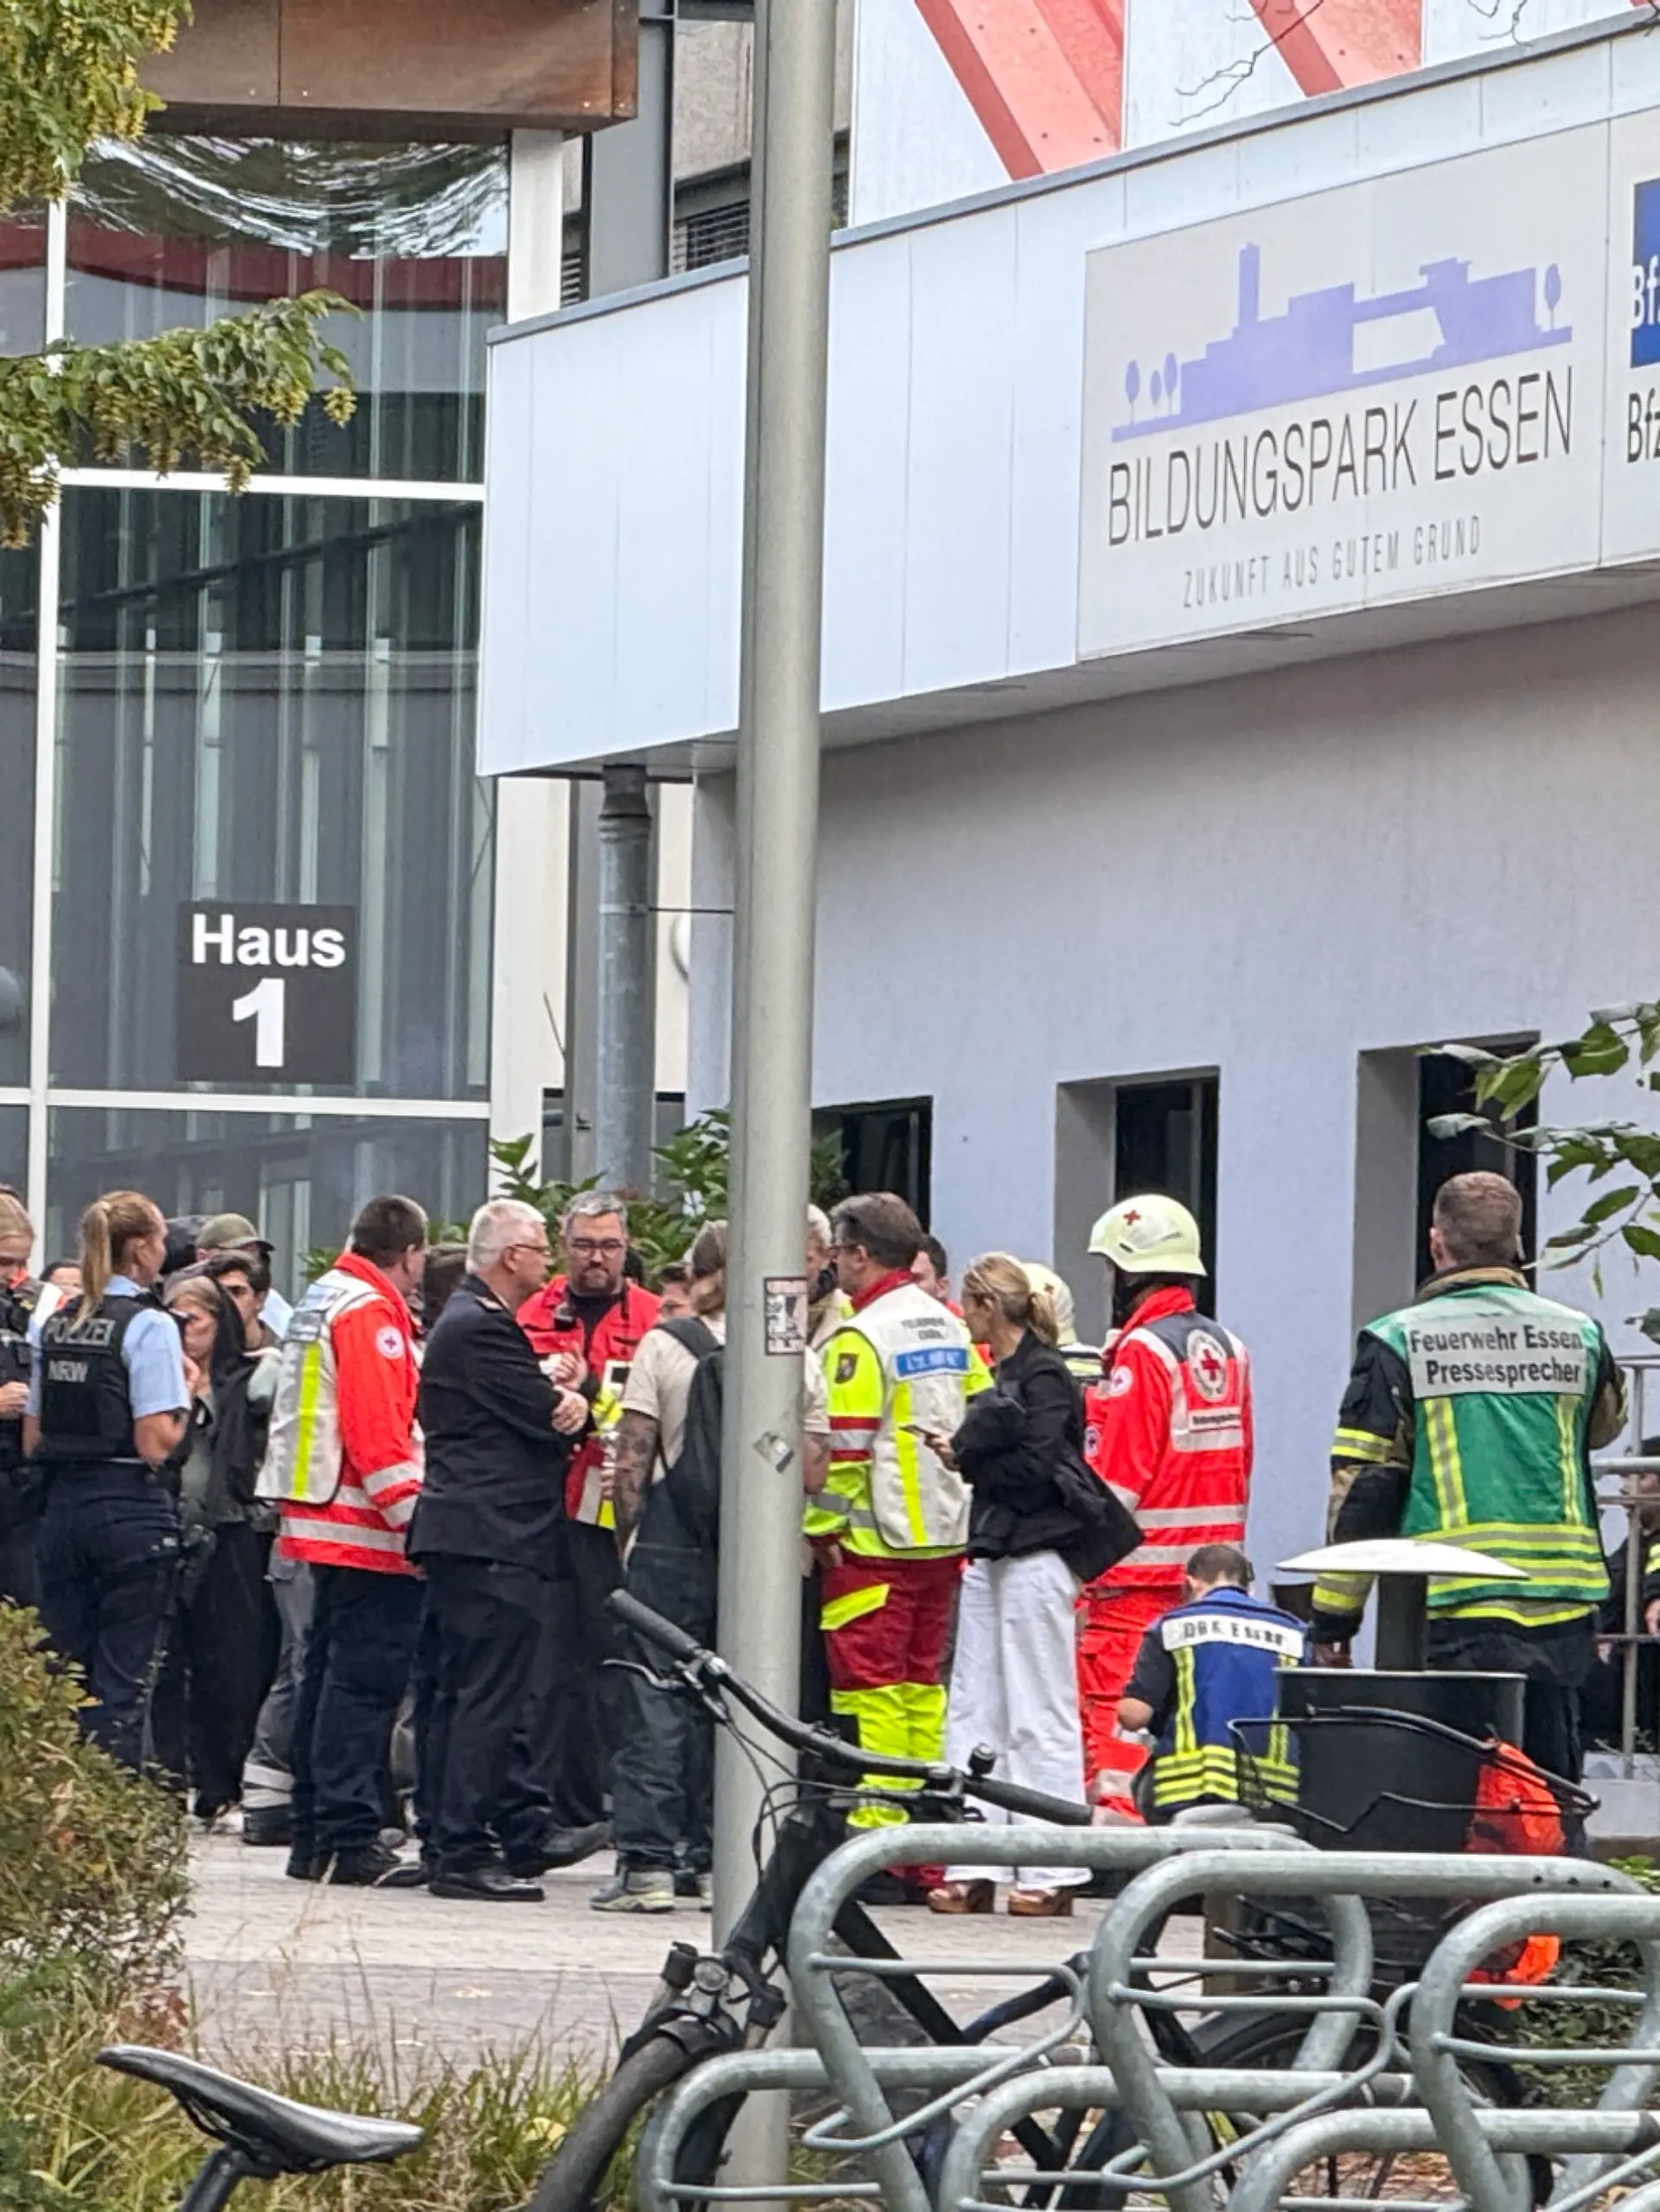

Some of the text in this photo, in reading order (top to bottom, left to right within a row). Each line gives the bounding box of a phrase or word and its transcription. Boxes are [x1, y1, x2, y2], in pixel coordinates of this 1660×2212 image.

[1630, 254, 1660, 328] Bf
[1108, 366, 1573, 547] BILDUNGSPARK ESSEN
[1183, 515, 1480, 608] ZUKUNFT AUS GUTEM GRUND
[193, 913, 346, 967] Haus
[232, 978, 284, 1068] 1
[1409, 1324, 1583, 1353] Feuerwehr Essen
[48, 1359, 89, 1383] NRW
[1426, 1355, 1581, 1389] Pressesprecher
